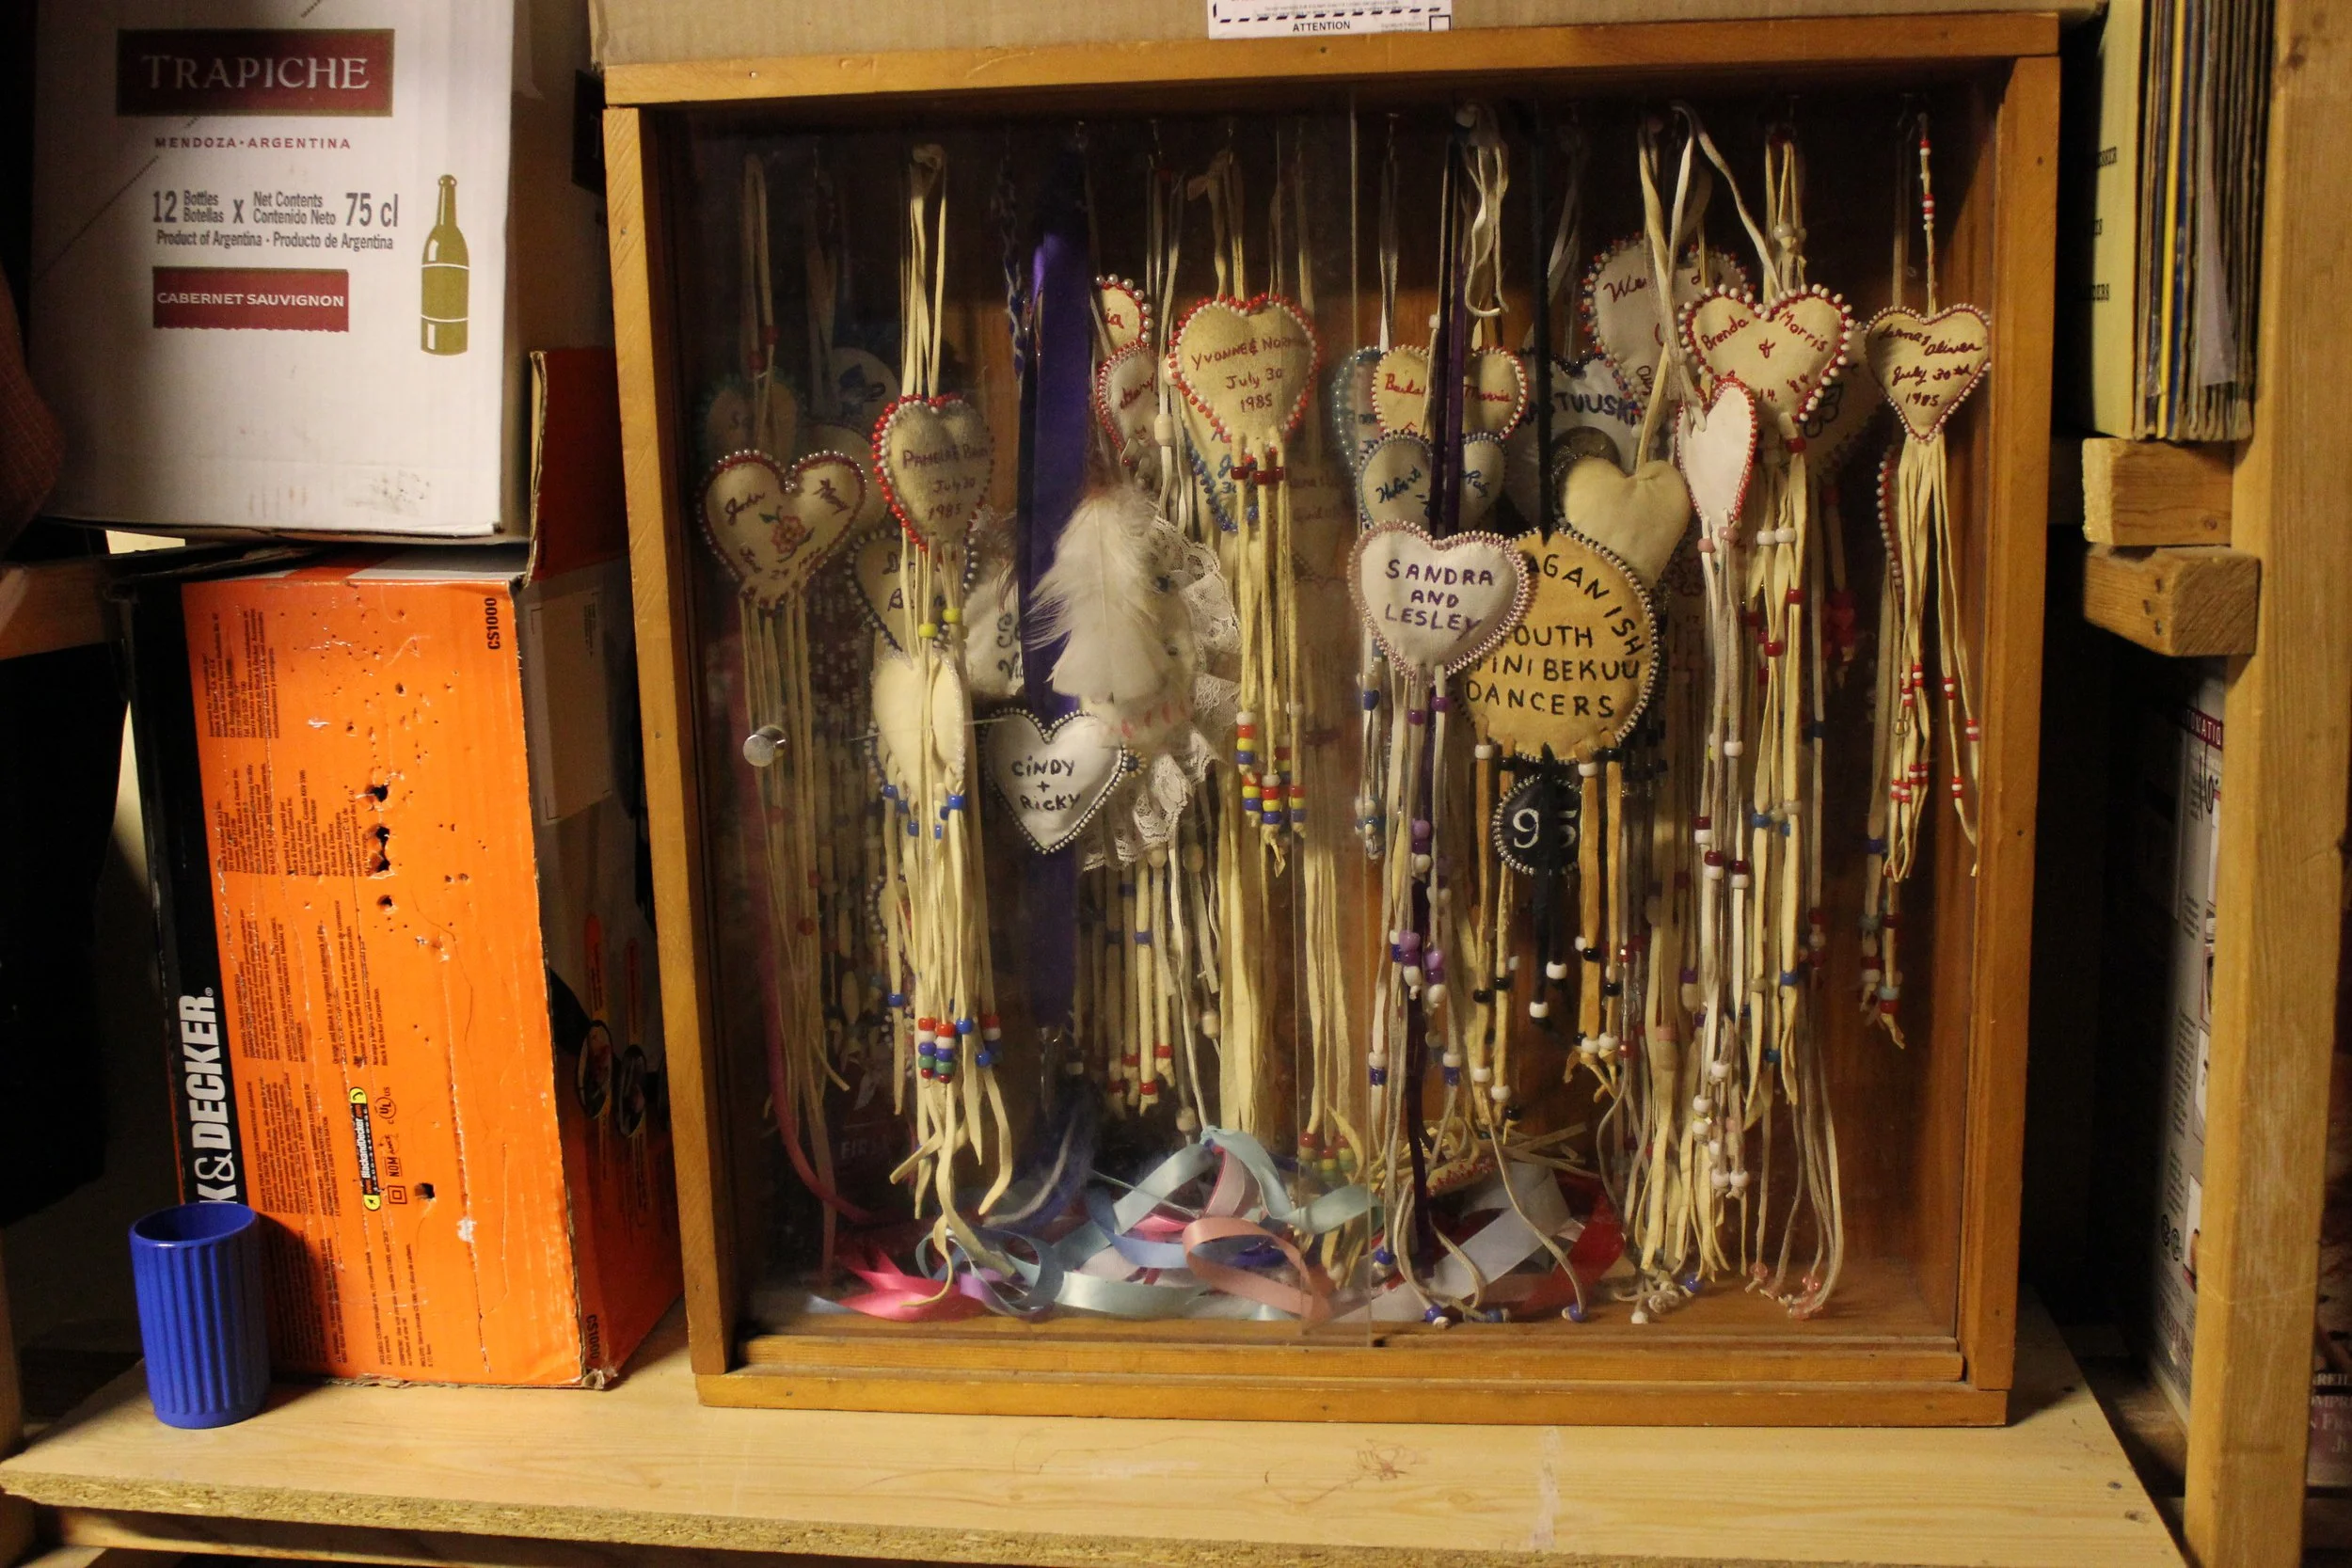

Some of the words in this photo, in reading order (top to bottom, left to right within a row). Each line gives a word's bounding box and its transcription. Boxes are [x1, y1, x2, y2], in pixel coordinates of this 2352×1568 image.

[1293, 21, 1351, 32] ATTENTION
[141, 54, 371, 90] TRAPICHE
[152, 190, 177, 224] 12
[183, 191, 219, 206] Bottles
[253, 191, 273, 207] Net
[276, 192, 324, 208] Contents
[344, 192, 373, 227] 75
[380, 193, 399, 228] cl
[183, 208, 225, 224] Botellas
[253, 208, 308, 225] Contenido
[310, 209, 337, 225] Neto
[157, 230, 197, 246] Product
[200, 230, 212, 245] of
[213, 230, 262, 248] Argentina
[273, 231, 322, 248] Producto
[325, 232, 339, 248] de
[342, 233, 393, 252] Argentina
[157, 292, 244, 306] CABERNET
[246, 293, 344, 308] SAUVIGNON
[1700, 316, 1750, 352] Brenda
[1780, 311, 1830, 351] Morris
[1226, 371, 1261, 390] July
[1891, 365, 1927, 388] July
[1240, 395, 1274, 413] 1985
[1904, 391, 1941, 407] 1985
[1385, 558, 1495, 587] SANDRA
[1410, 588, 1460, 610] AND
[486, 596, 501, 651] CS1000
[1384, 602, 1483, 642] LESLEY
[1465, 679, 1614, 719] DANCERS
[380, 1102, 390, 1114] UL
[387, 1157, 399, 1176] NOM
